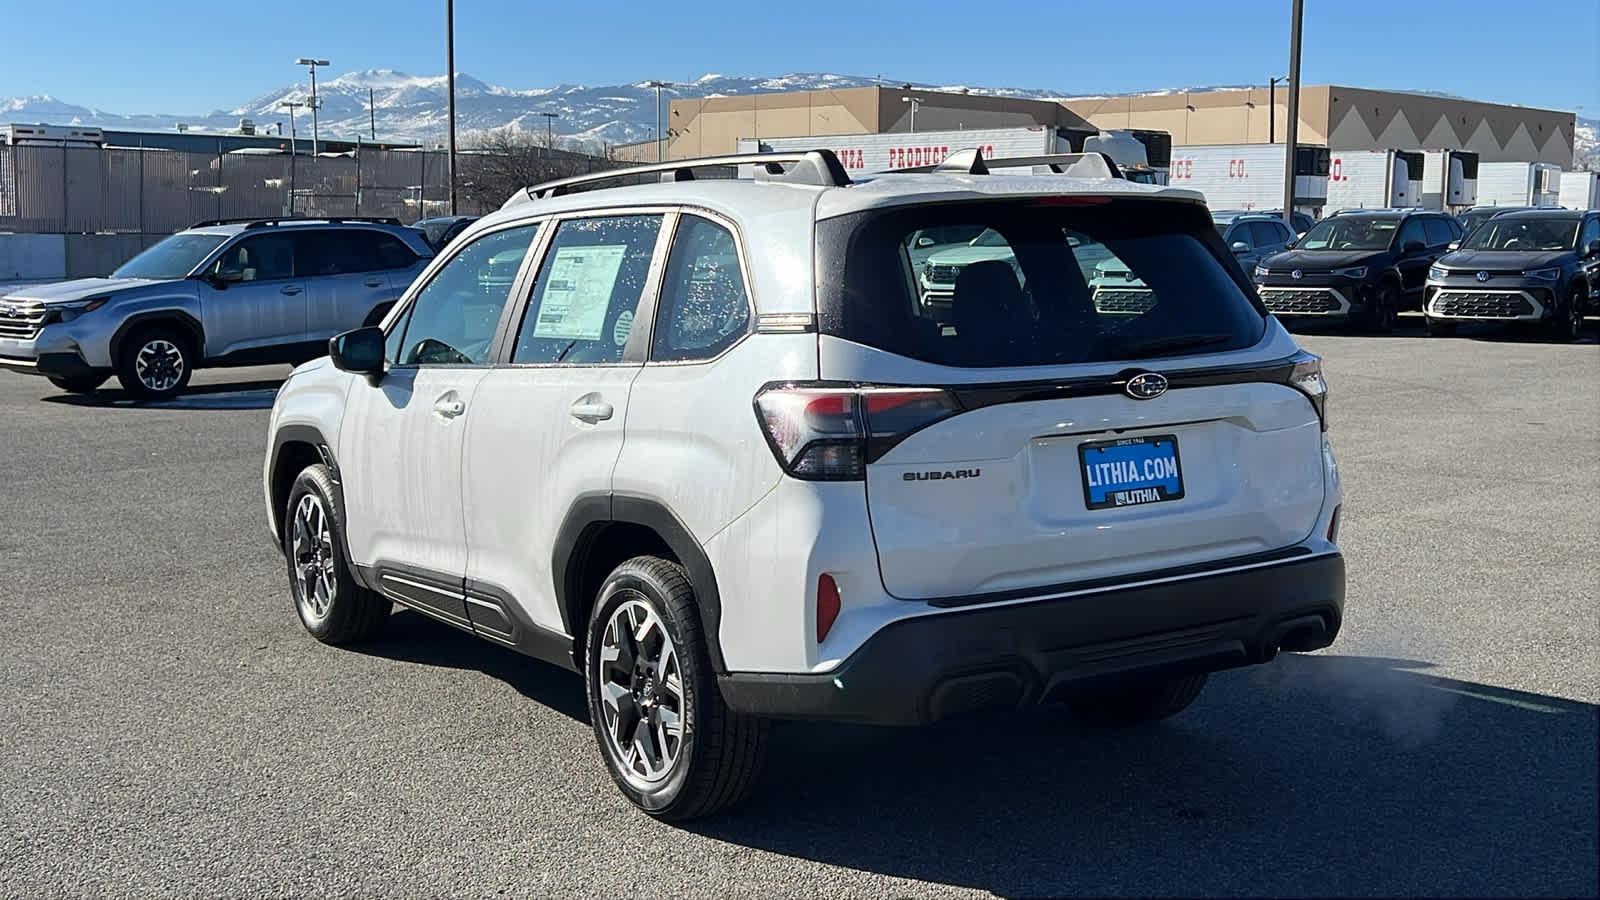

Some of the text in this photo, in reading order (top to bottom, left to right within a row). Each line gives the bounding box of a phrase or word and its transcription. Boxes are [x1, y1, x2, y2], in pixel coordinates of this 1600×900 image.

[834, 149, 864, 168] NZA
[889, 146, 948, 168] PRODUCE
[1229, 160, 1249, 178] CO.
[1328, 159, 1347, 181] O.
[903, 468, 981, 481] SUBARU
[1086, 456, 1178, 487] LITHIA.COM
[1125, 487, 1160, 504] LITHIA
